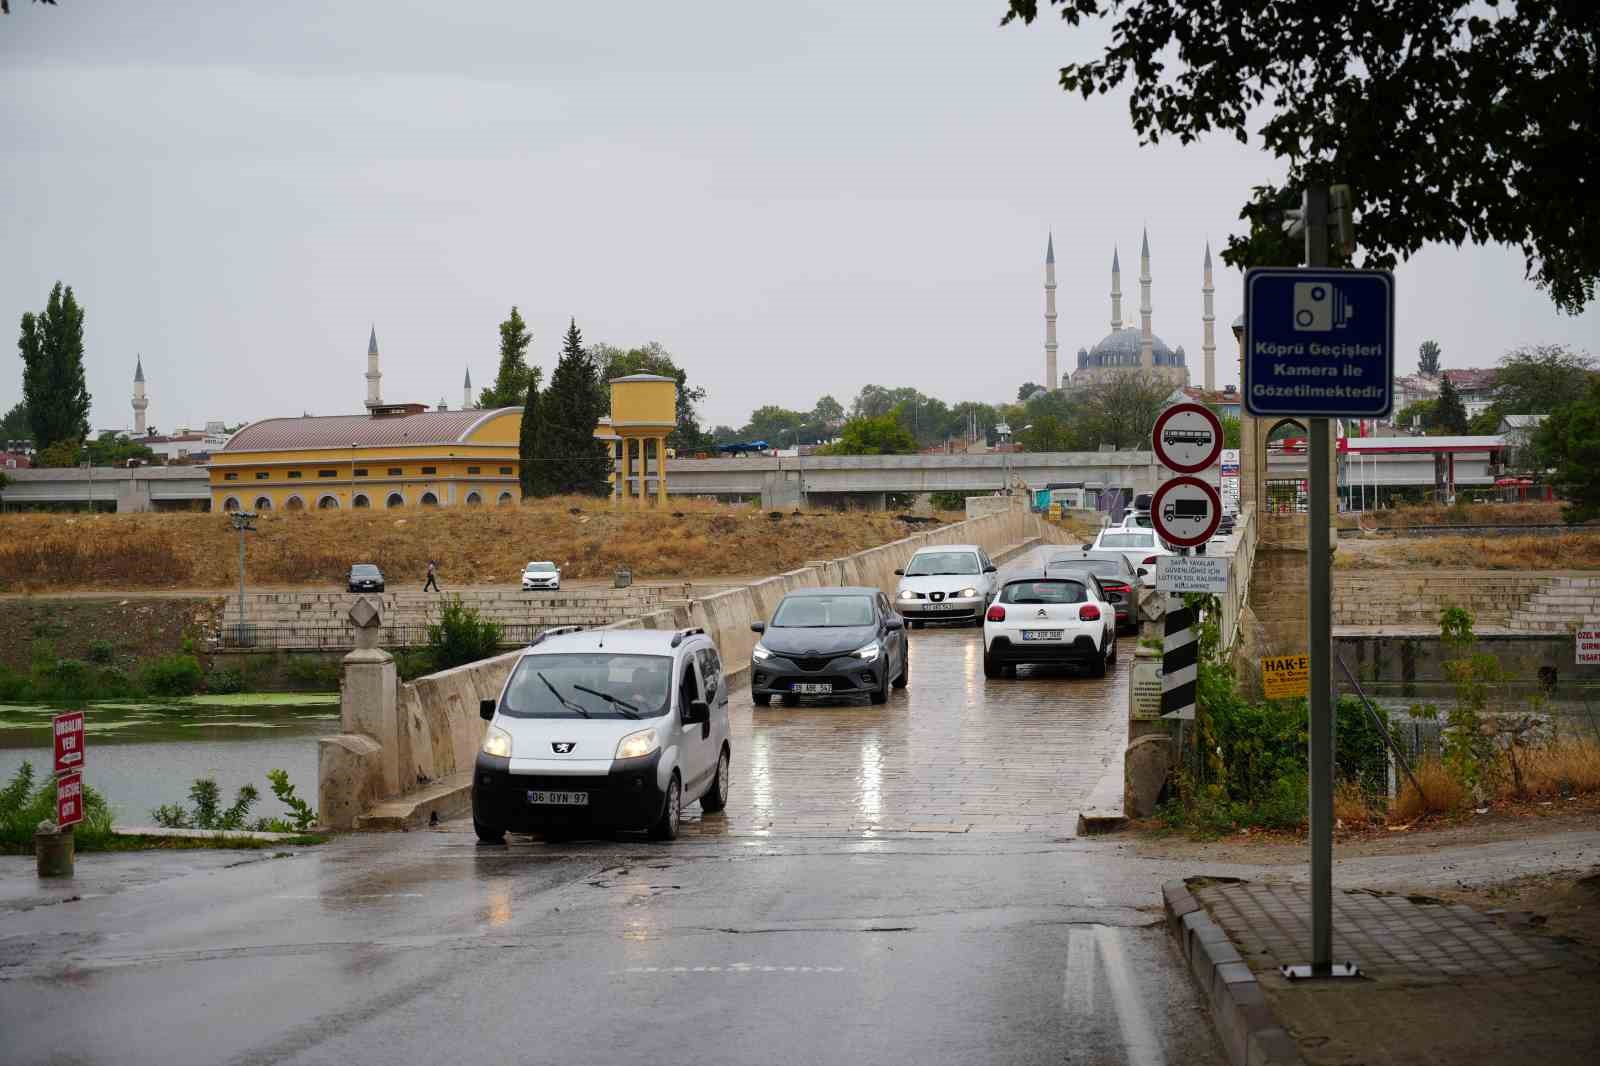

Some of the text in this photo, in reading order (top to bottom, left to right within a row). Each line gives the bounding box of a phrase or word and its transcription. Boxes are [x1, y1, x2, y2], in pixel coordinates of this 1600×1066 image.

[1256, 342, 1382, 359] Köprü Geçişleri
[1274, 363, 1363, 376] Kamera ile
[1253, 384, 1384, 397] Gözetilmektedir
[532, 792, 545, 802] 06
[574, 793, 586, 803] 97
